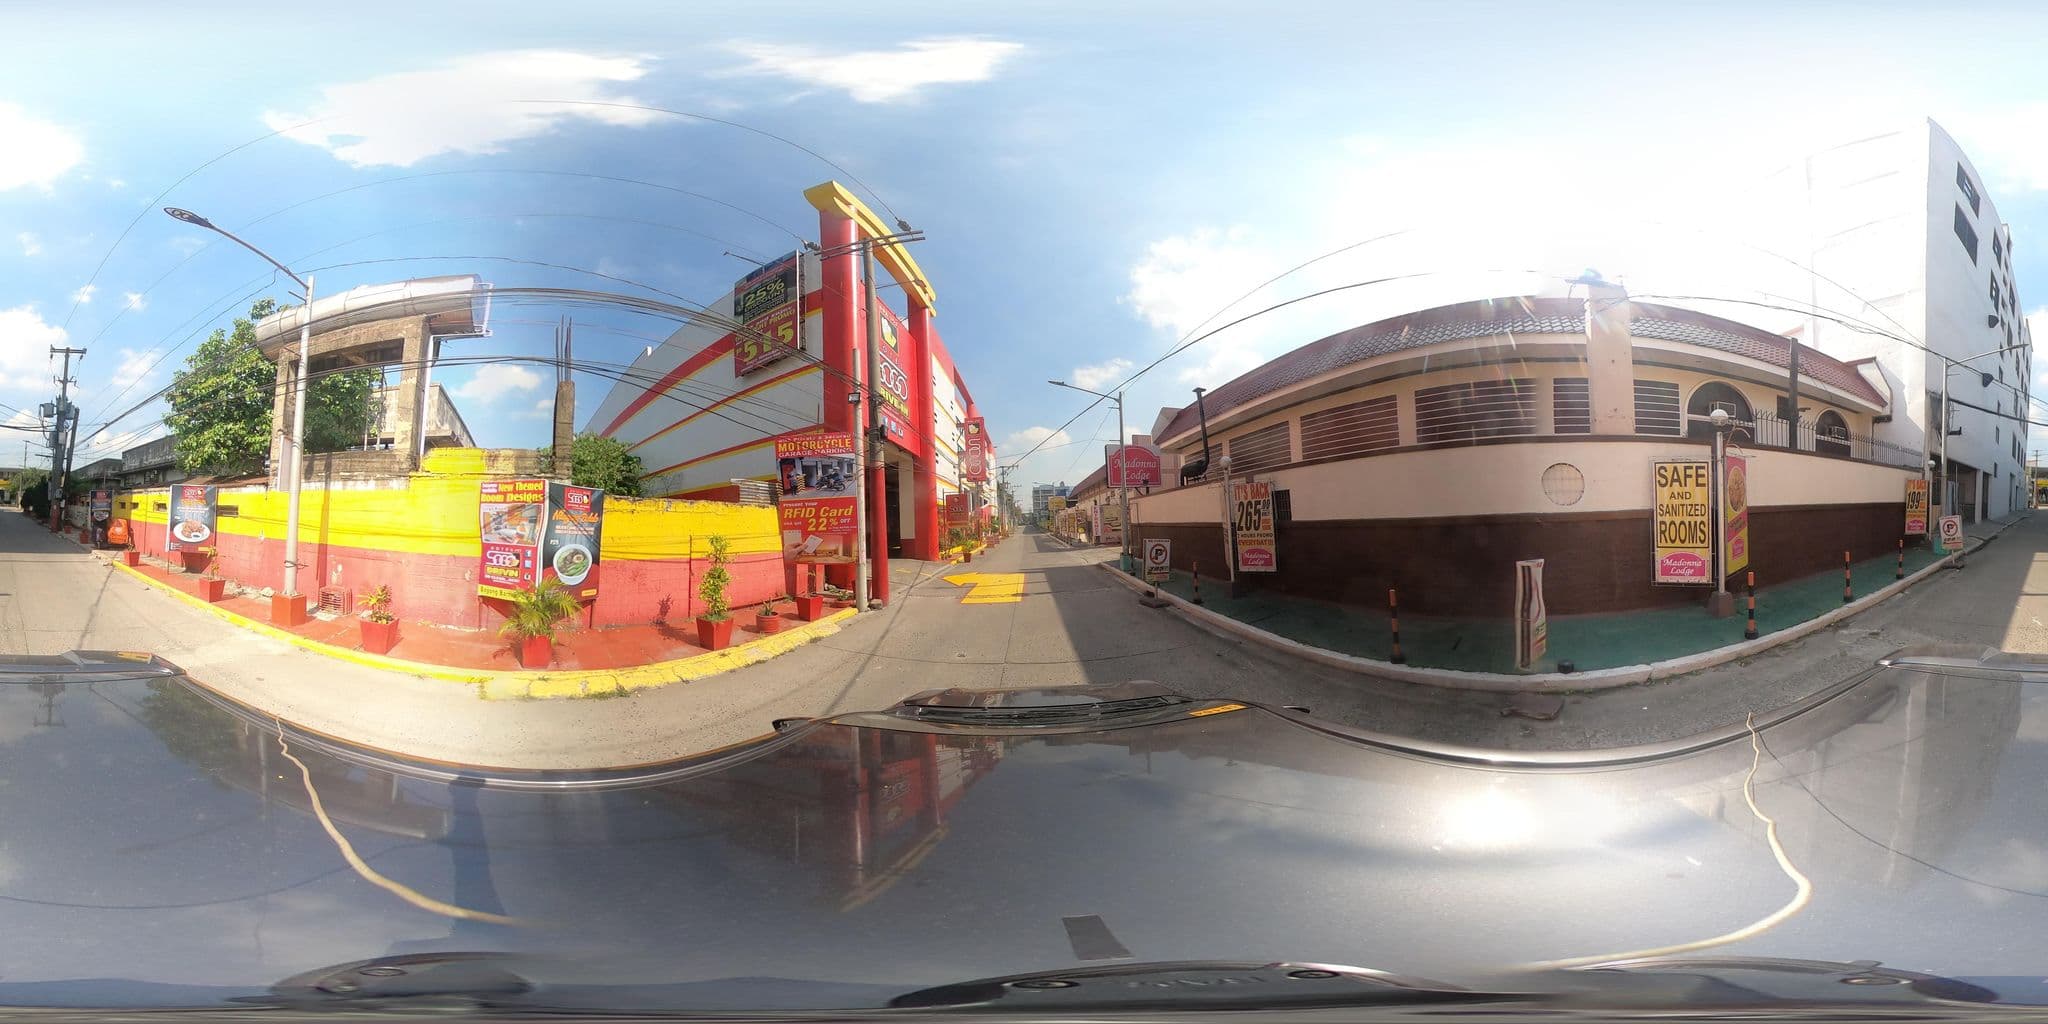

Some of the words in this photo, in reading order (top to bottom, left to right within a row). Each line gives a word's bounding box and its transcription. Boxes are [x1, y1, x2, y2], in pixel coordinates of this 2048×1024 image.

[745, 279, 785, 307] 25%
[778, 438, 852, 453] MOTORCYCLE
[778, 450, 813, 458] GARAGE
[1114, 458, 1156, 469] Madonna
[1126, 469, 1150, 481] Lodge
[1657, 466, 1706, 488] SAFE
[498, 483, 514, 492] New
[515, 481, 543, 490] Themed
[1234, 485, 1249, 501] IT'S
[1250, 482, 1270, 499] BACK
[506, 493, 544, 504] Designs
[1669, 491, 1692, 500] AND
[1906, 490, 1921, 509] 199
[784, 505, 816, 519] RFID
[820, 503, 854, 517] Card
[1237, 500, 1262, 531] 265
[1658, 503, 1707, 517] SANITIZED
[1659, 520, 1707, 544] ROOMS
[1663, 559, 1702, 567] Madonna
[1670, 567, 1694, 576] Lodge
